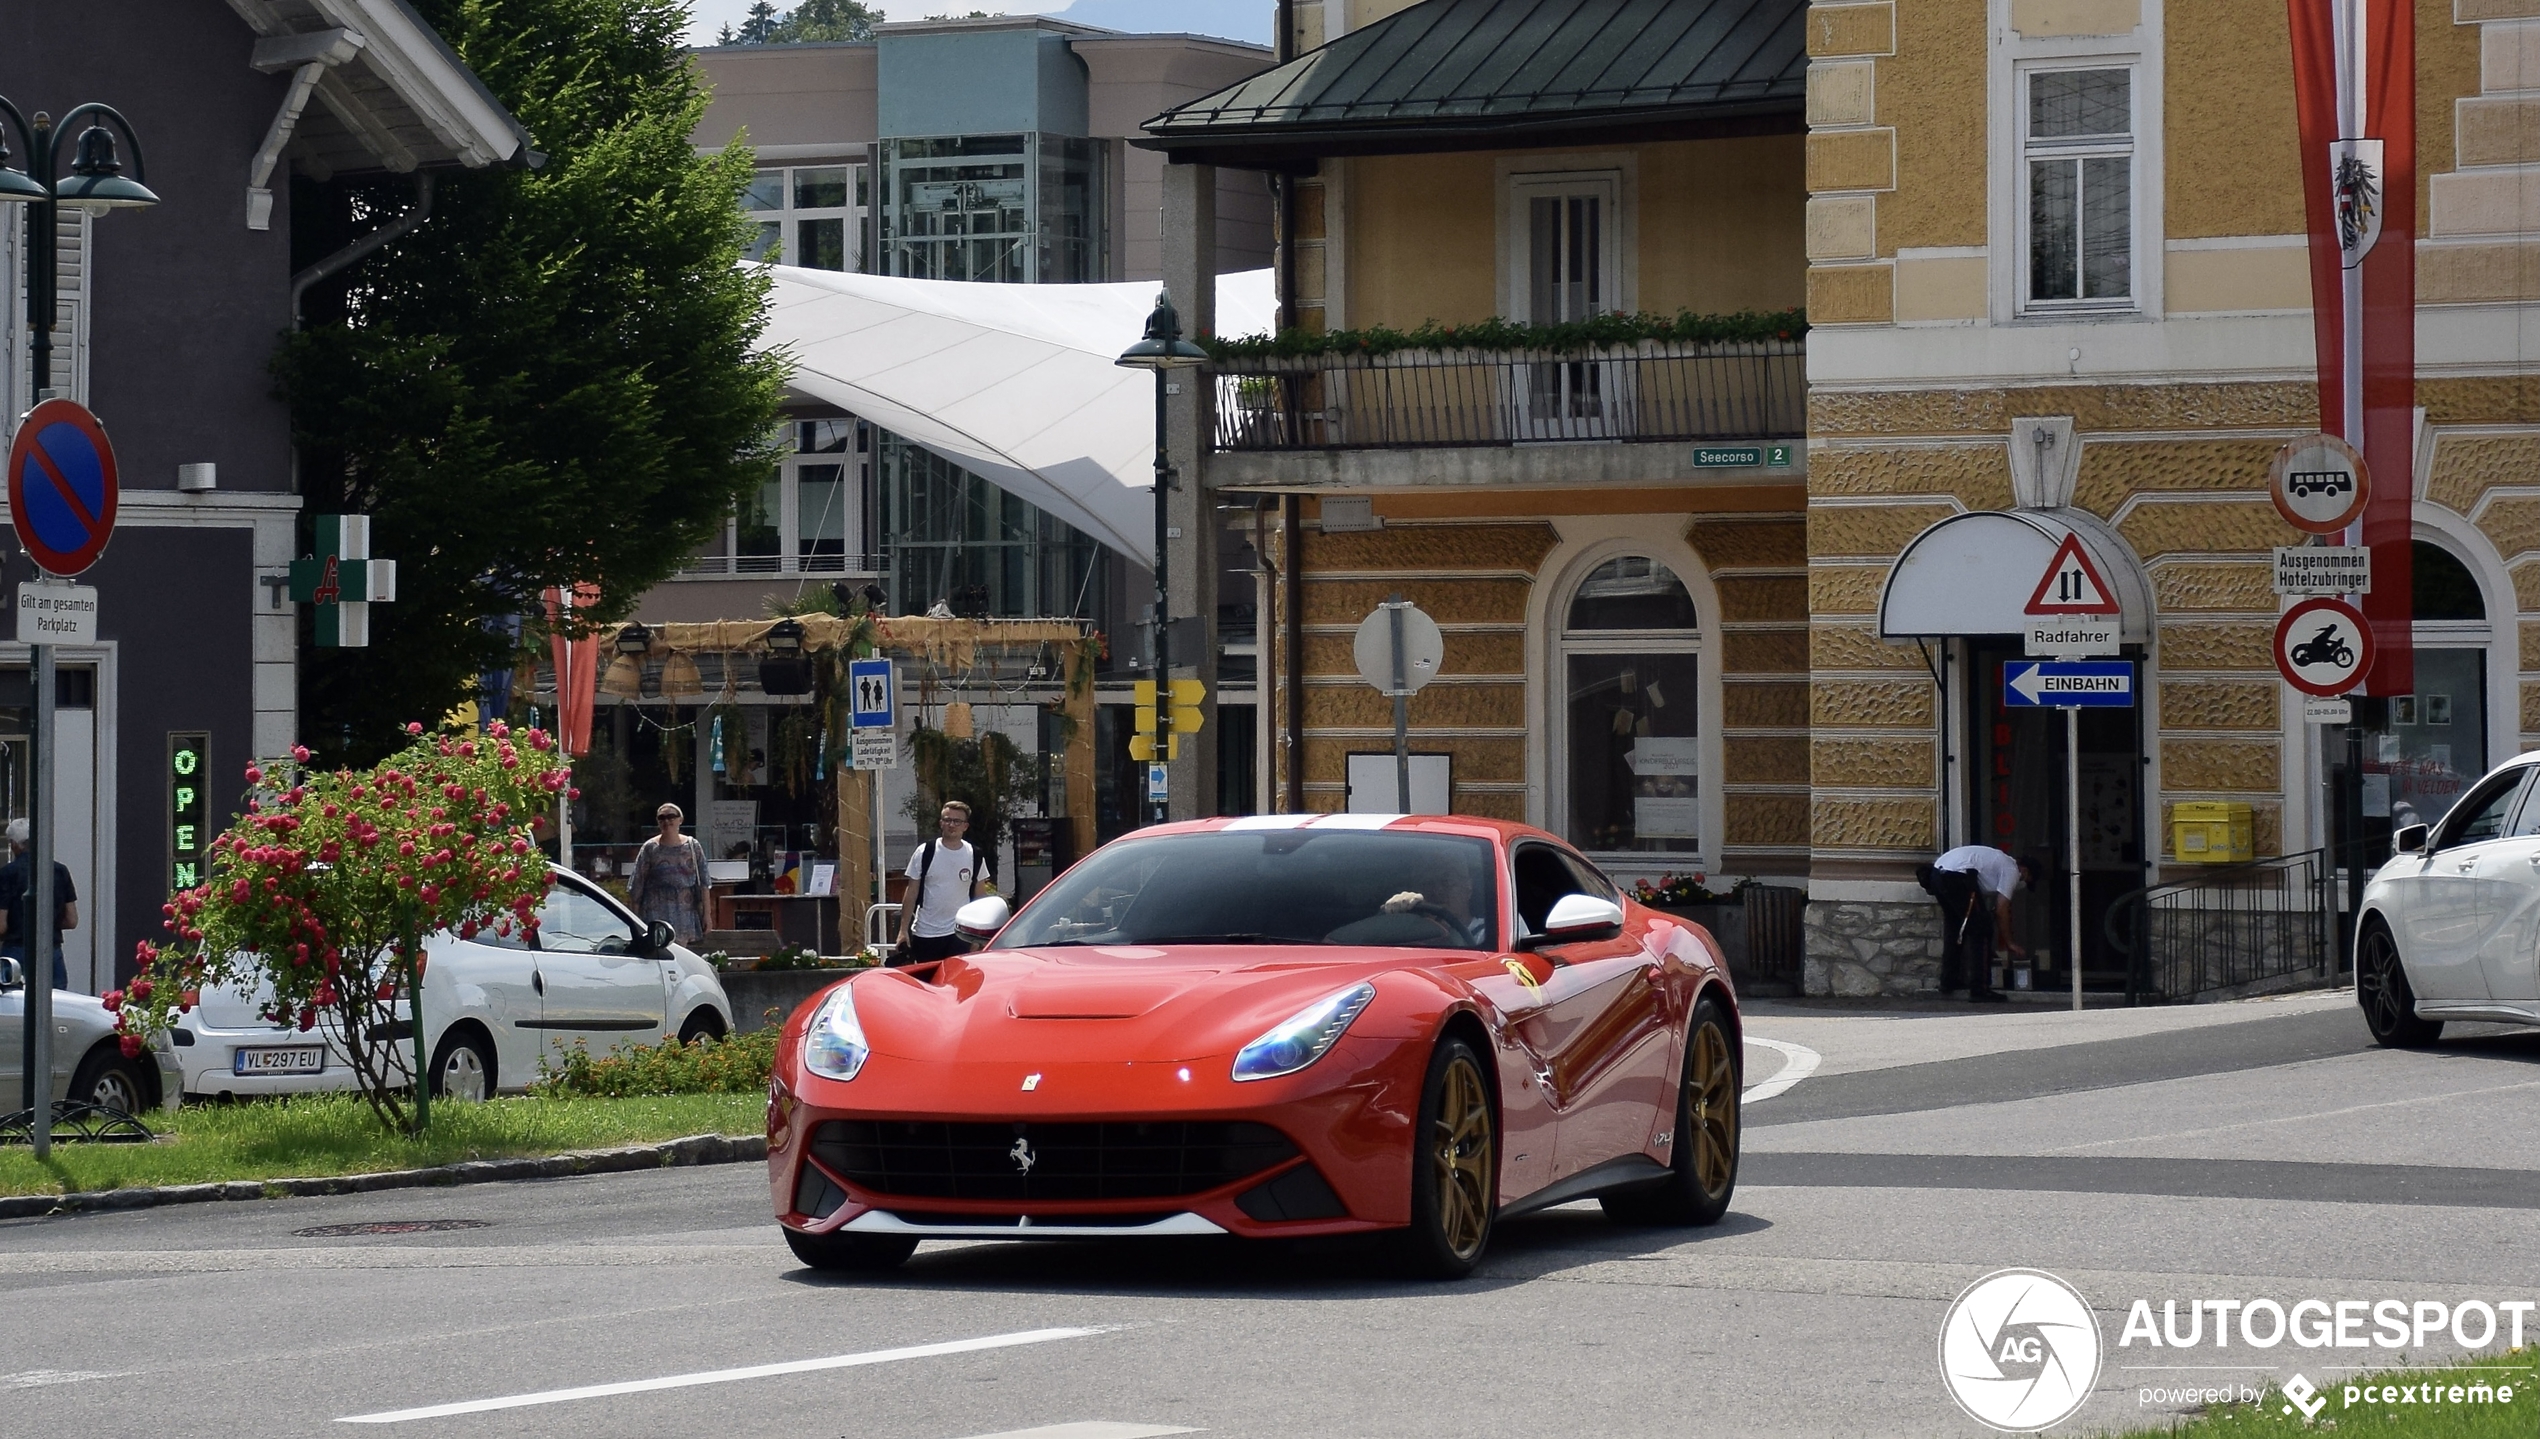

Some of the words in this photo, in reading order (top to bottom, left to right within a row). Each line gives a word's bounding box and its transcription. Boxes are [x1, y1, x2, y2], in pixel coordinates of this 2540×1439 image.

[1700, 451, 1754, 463] Seecorso
[1774, 448, 1783, 460] 2
[2280, 553, 2365, 570] Ausgenommen
[2280, 571, 2367, 588] Hotelzubringer
[21, 594, 36, 609] Gilt
[38, 598, 51, 609] am
[53, 599, 95, 613] gesamten
[37, 617, 77, 634] Parkplatz
[2034, 630, 2110, 643] Radfahrer
[2044, 677, 2120, 691] EINBAHN
[2418, 778, 2461, 795] VELDEN
[174, 749, 197, 888] OPEN
[272, 1052, 296, 1068] 297
[299, 1052, 316, 1067] EU
